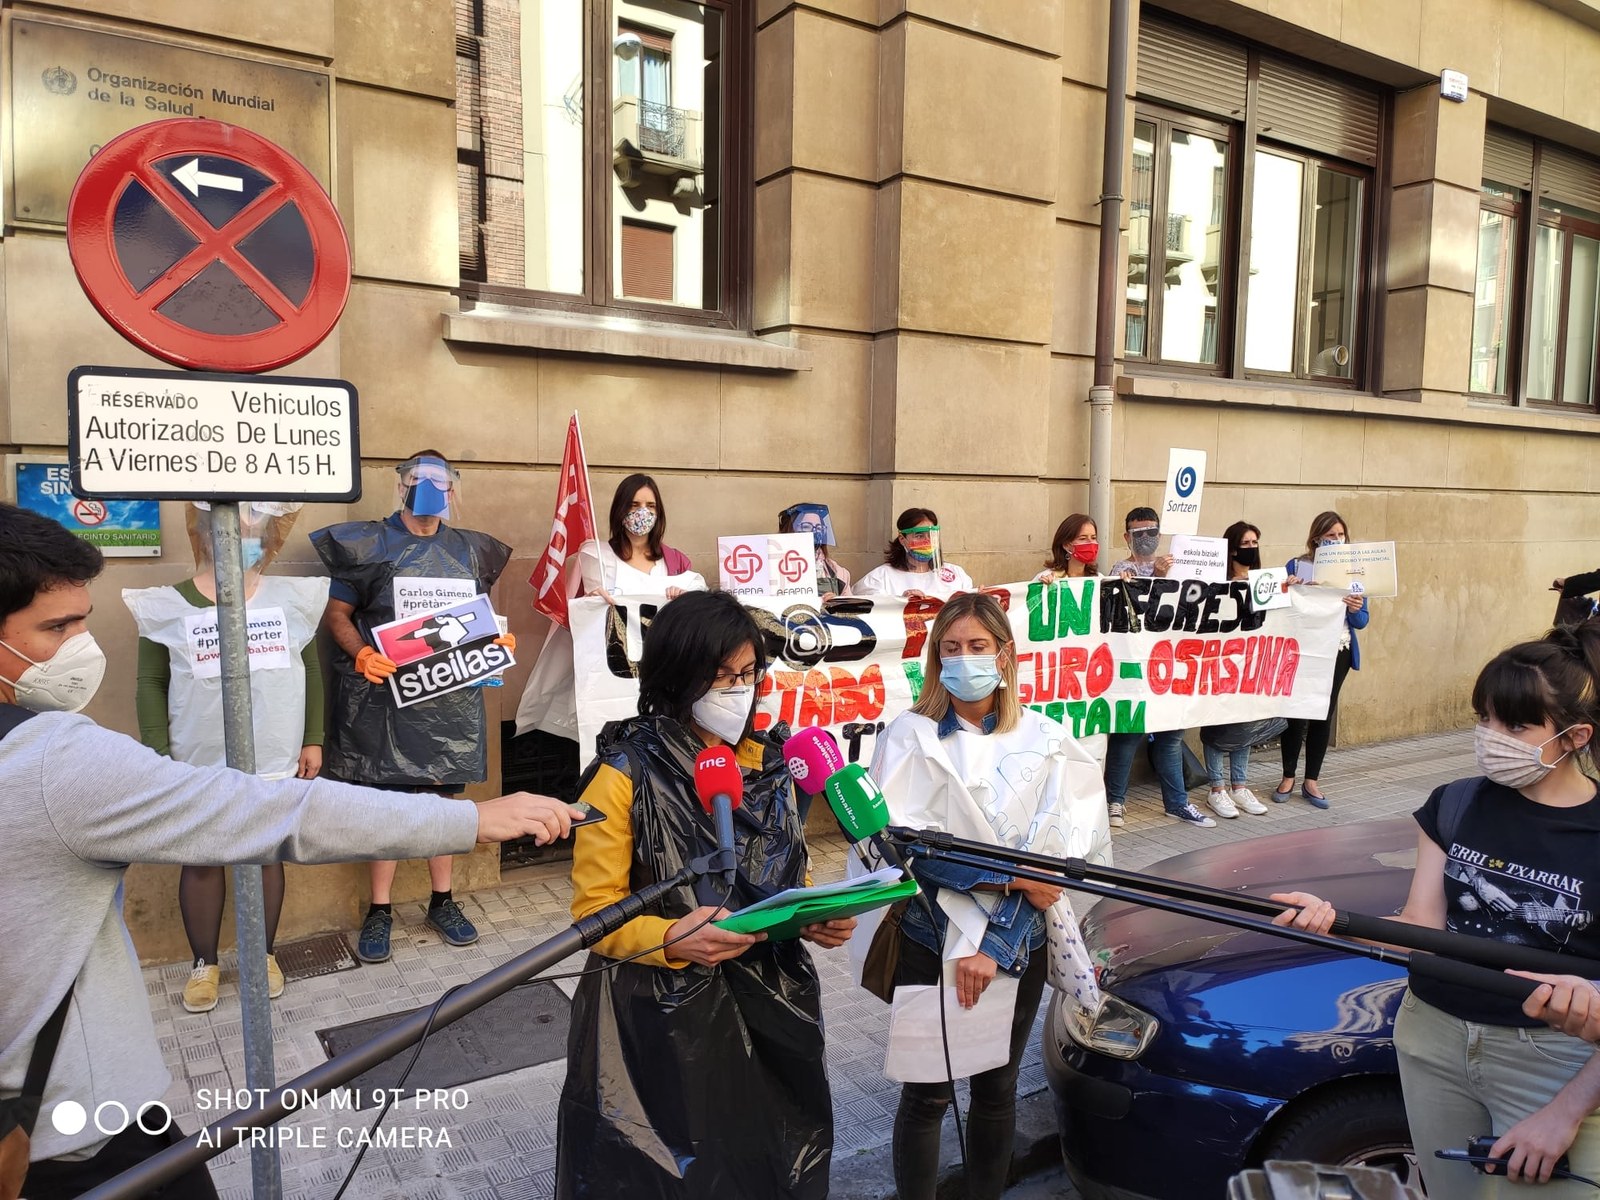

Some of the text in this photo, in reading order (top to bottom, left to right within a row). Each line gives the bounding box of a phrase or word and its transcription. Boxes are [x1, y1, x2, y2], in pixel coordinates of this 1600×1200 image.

[87, 67, 275, 112] Organización Mundial
[88, 88, 194, 116] de la Salud
[231, 391, 341, 417] Vehiculos
[86, 416, 341, 447] Autorizados De Lunes
[84, 448, 336, 476] A Viernes De 8 A 15 H.
[46, 468, 70, 481] ES
[1166, 500, 1198, 513] Sortzen
[77, 533, 157, 541] ECINTO SANITARIO
[1174, 559, 1208, 567] onzentrazio
[399, 588, 473, 598] Carlos Gimeno
[776, 587, 814, 597] AFAPNA
[1258, 582, 1278, 595] CSIF
[1026, 580, 1094, 641] UN
[192, 619, 282, 636] Carl meno
[196, 652, 221, 662] Low
[1147, 635, 1300, 698] OSASUNA
[400, 643, 505, 698] steilas
[700, 757, 727, 771] rne
[812, 735, 837, 774] uskalerria
[1448, 843, 1584, 895] ERRI TXARRAK
